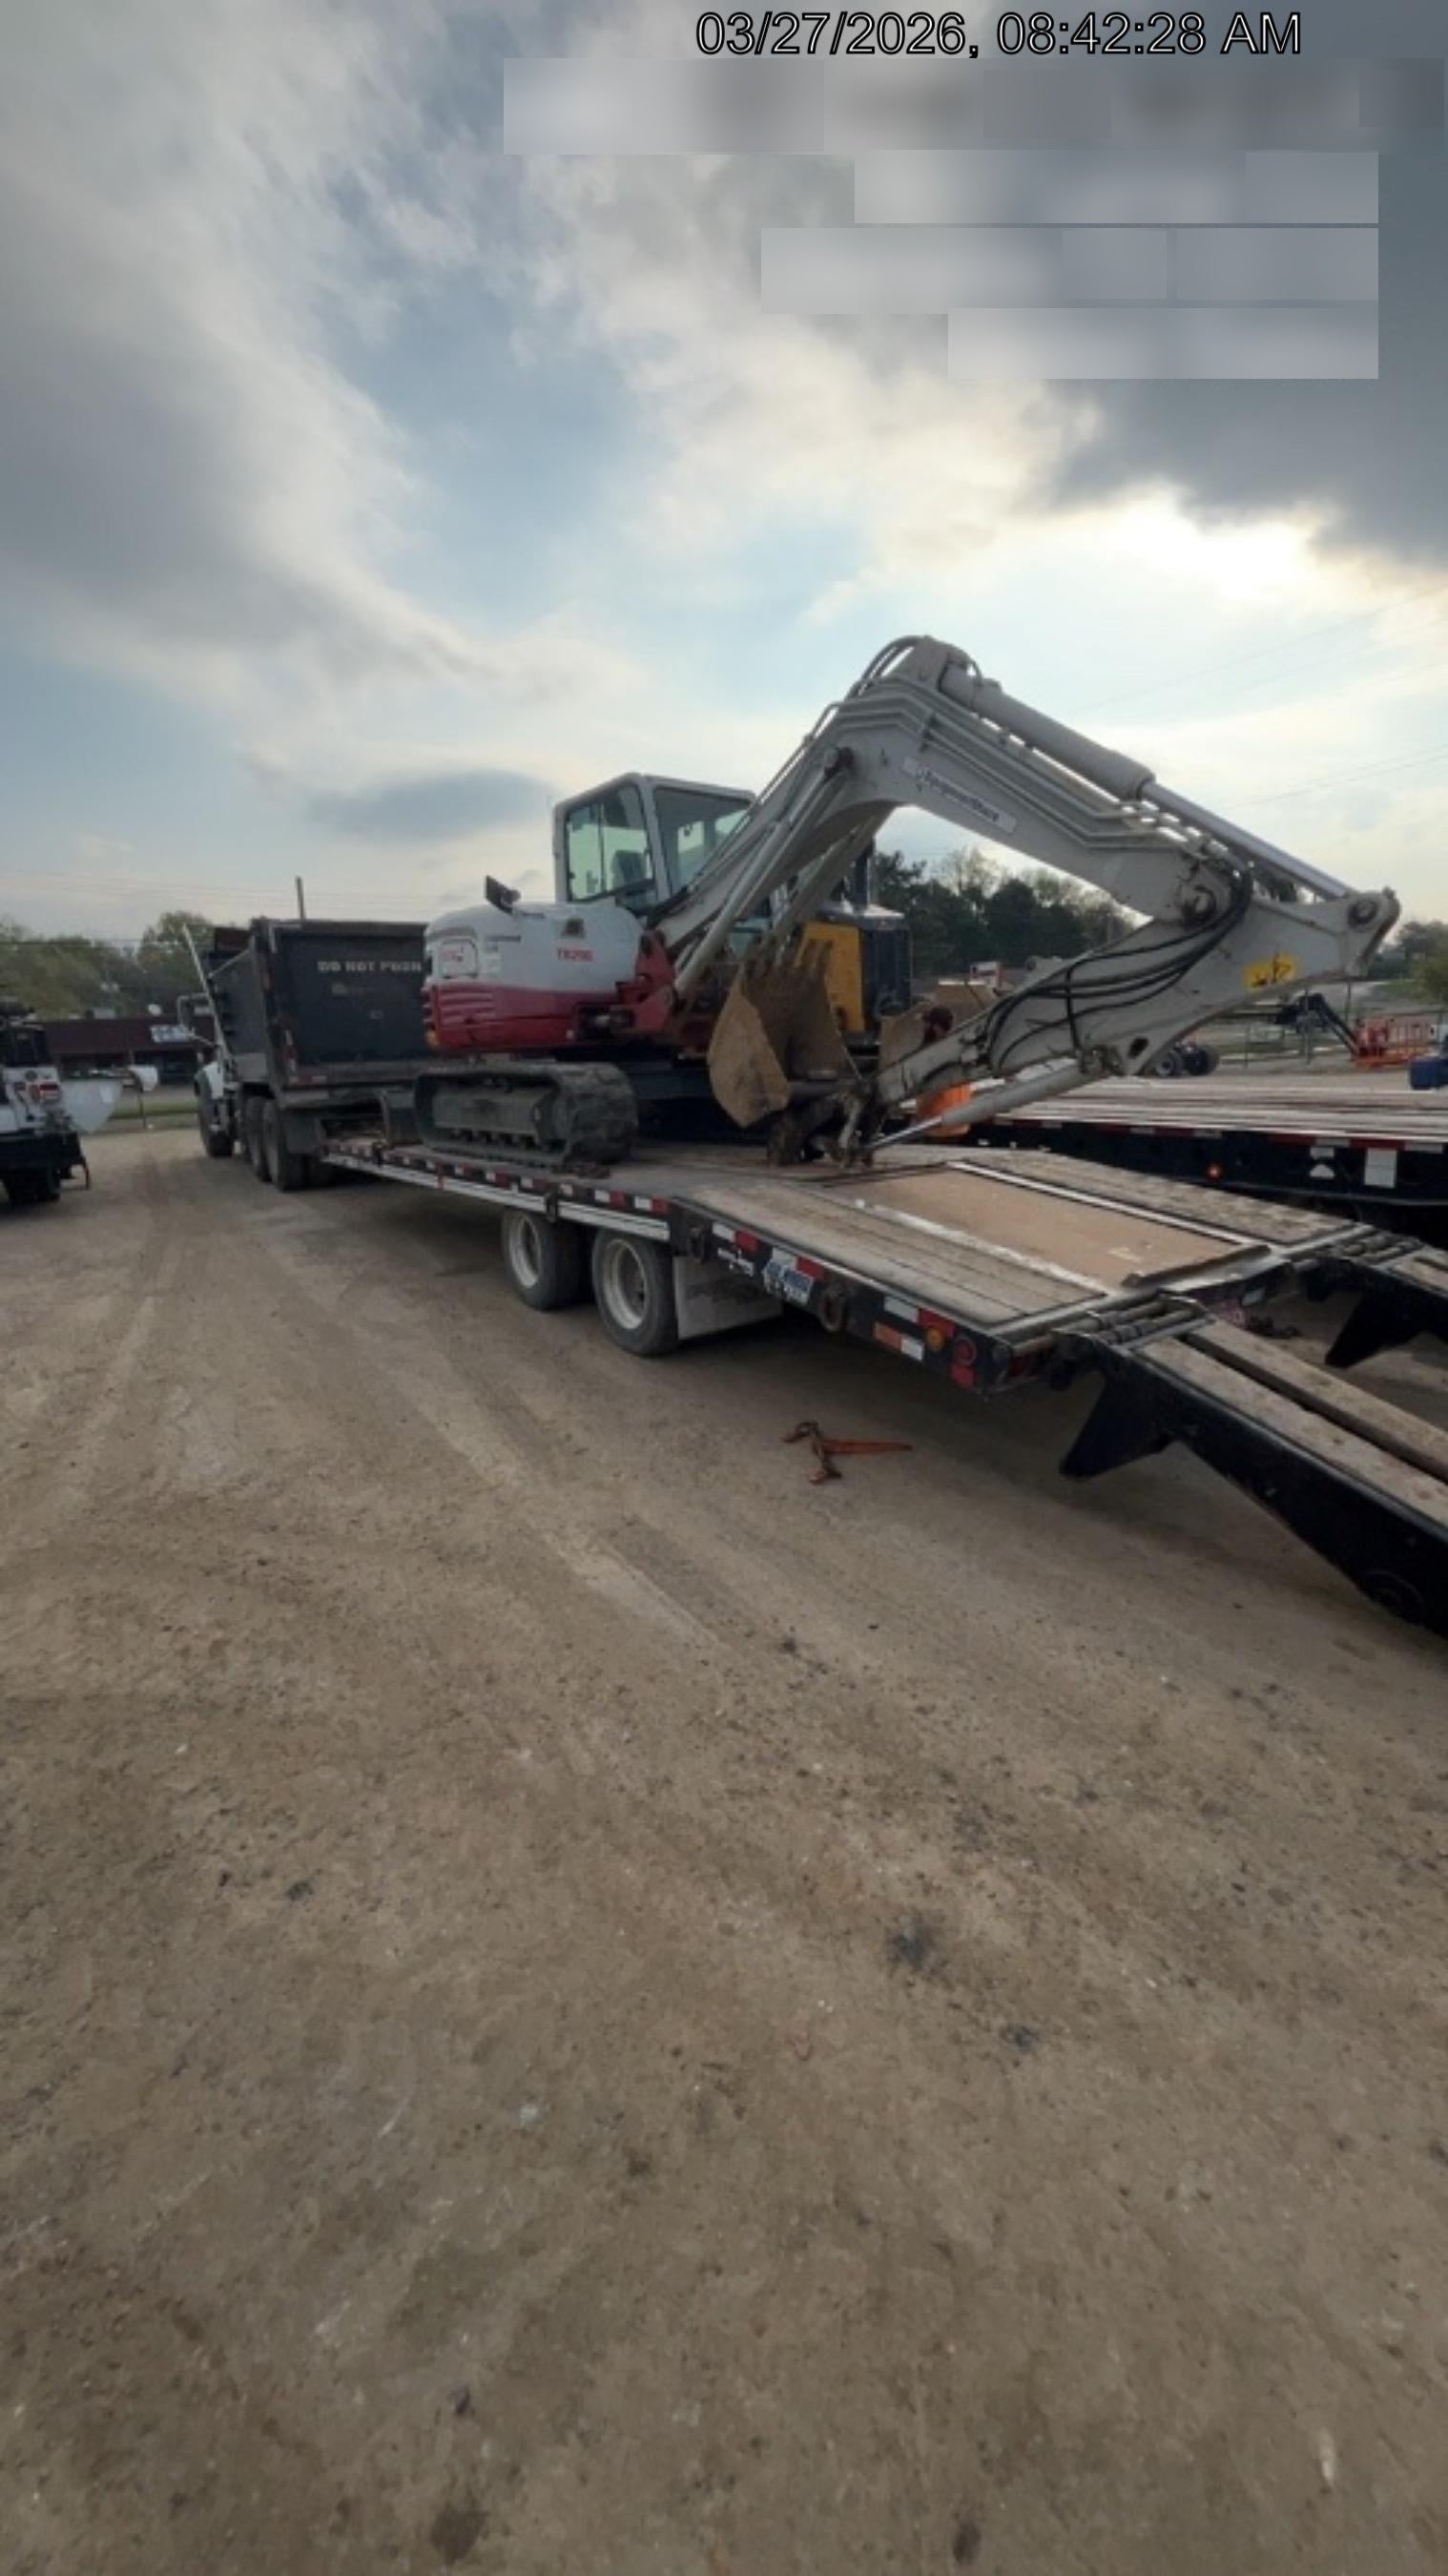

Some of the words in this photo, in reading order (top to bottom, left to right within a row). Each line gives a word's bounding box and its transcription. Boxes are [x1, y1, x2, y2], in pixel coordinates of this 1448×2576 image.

[317, 961, 341, 972] DO
[345, 961, 375, 972] NOT
[380, 961, 422, 972] PUSH
